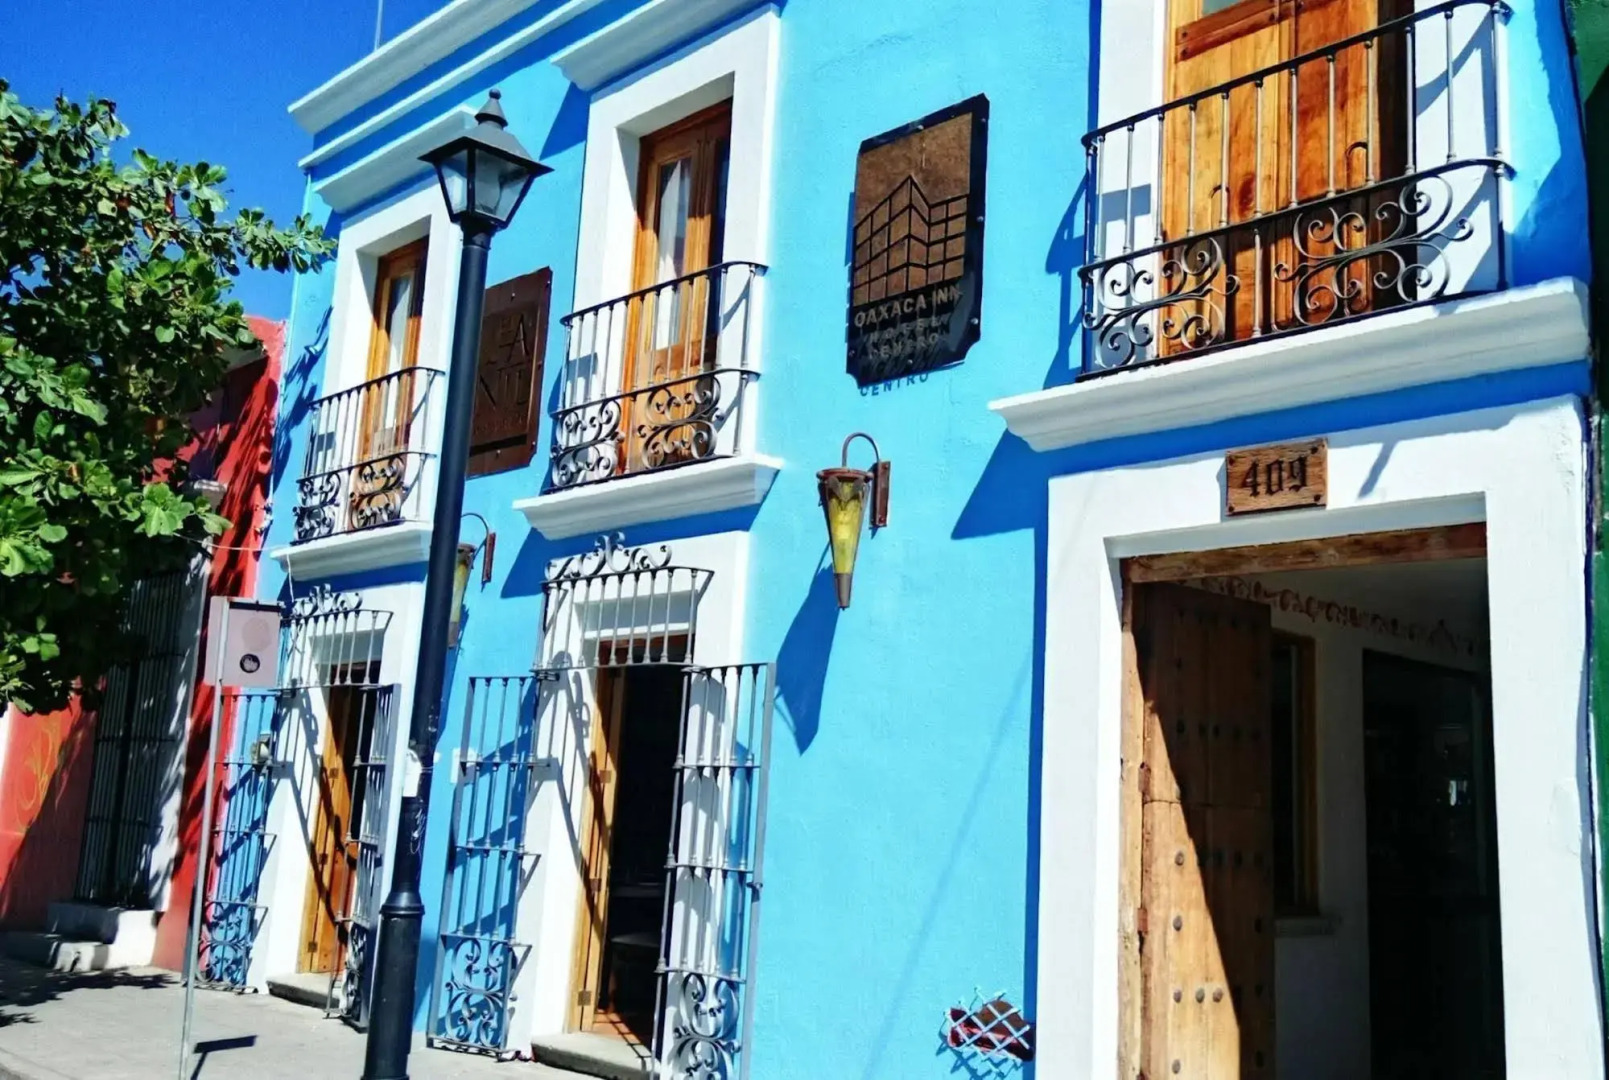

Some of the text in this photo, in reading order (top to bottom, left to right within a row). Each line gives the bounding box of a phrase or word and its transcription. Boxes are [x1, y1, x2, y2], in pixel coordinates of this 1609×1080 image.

[854, 284, 962, 328] OAXACA INN
[1241, 455, 1308, 497] 409
